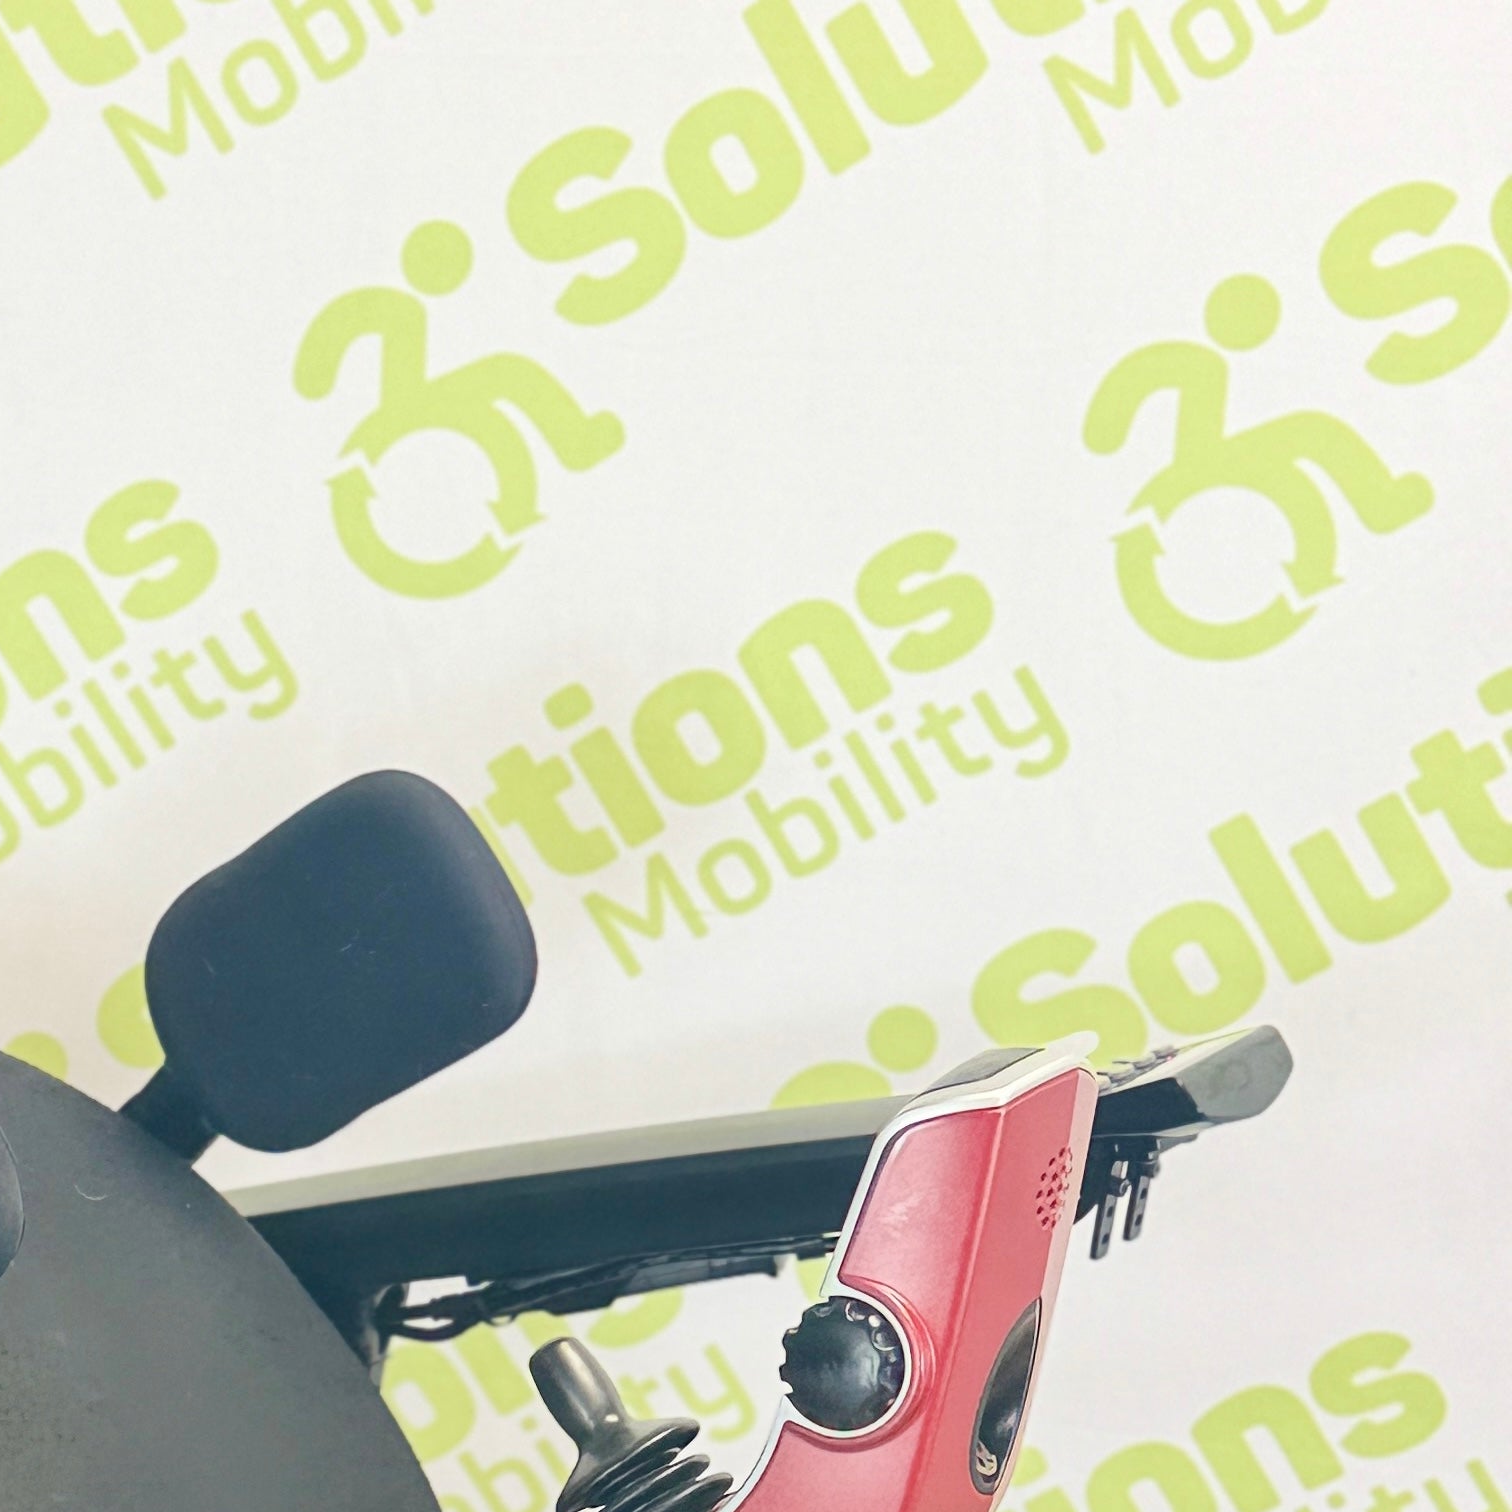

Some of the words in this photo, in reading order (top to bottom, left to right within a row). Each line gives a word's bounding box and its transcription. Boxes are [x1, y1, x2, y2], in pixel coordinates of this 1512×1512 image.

[505, 0, 1088, 326] Solu
[1042, 0, 1331, 154] Mo
[1318, 174, 1512, 385] S
[469, 530, 996, 908] tions
[582, 665, 1071, 978] Mobility
[970, 665, 1512, 1070] Solut
